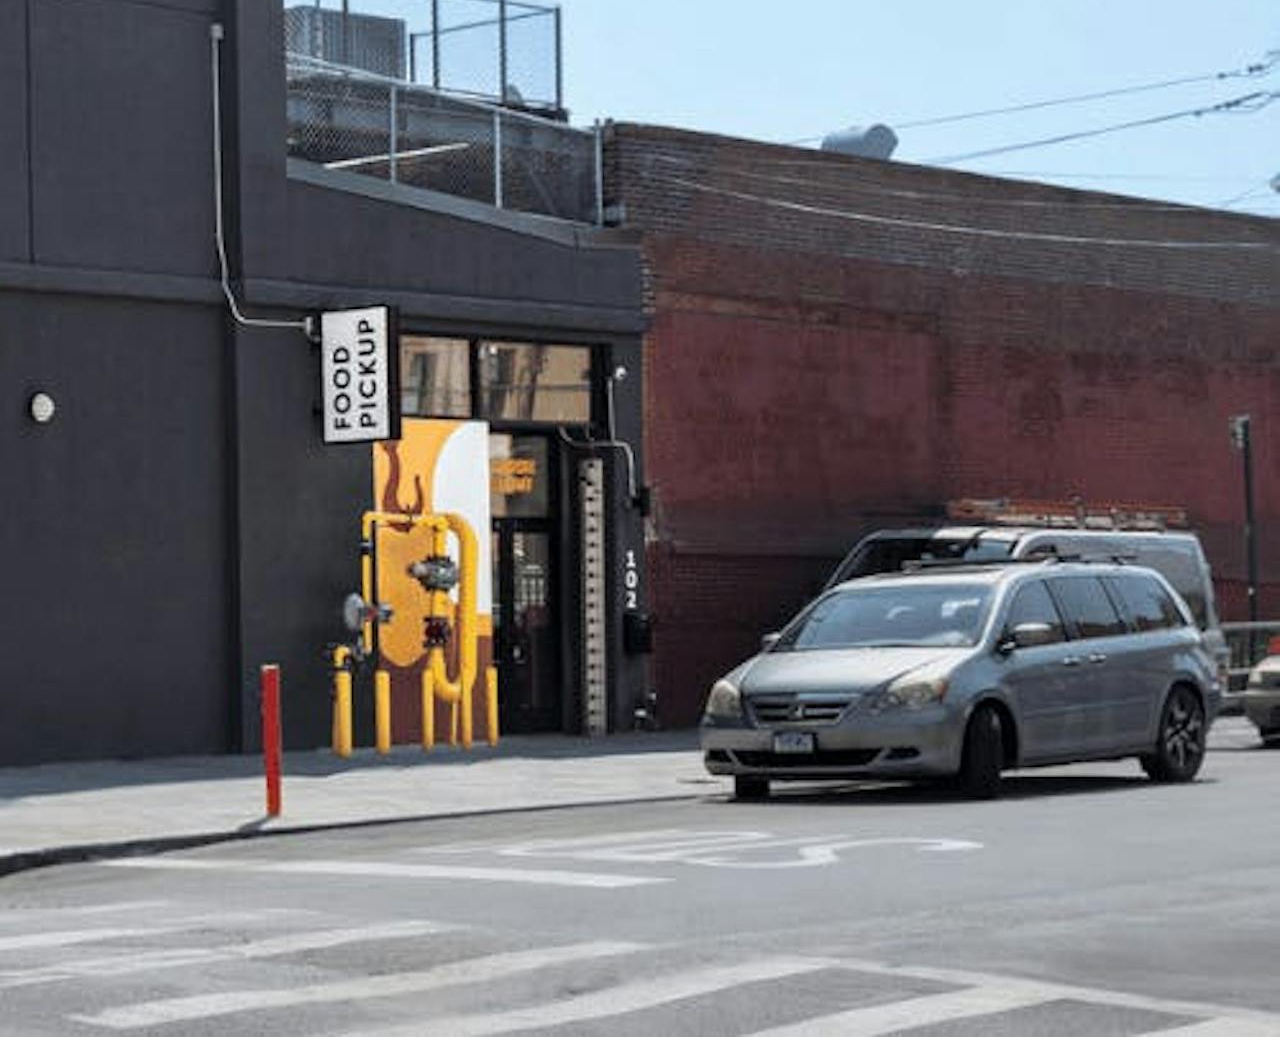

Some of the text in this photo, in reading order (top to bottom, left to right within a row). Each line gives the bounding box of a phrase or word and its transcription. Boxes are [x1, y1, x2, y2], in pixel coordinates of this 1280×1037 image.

[333, 347, 351, 430] FOOD
[358, 319, 377, 428] PICKUP
[625, 549, 638, 610] 102
